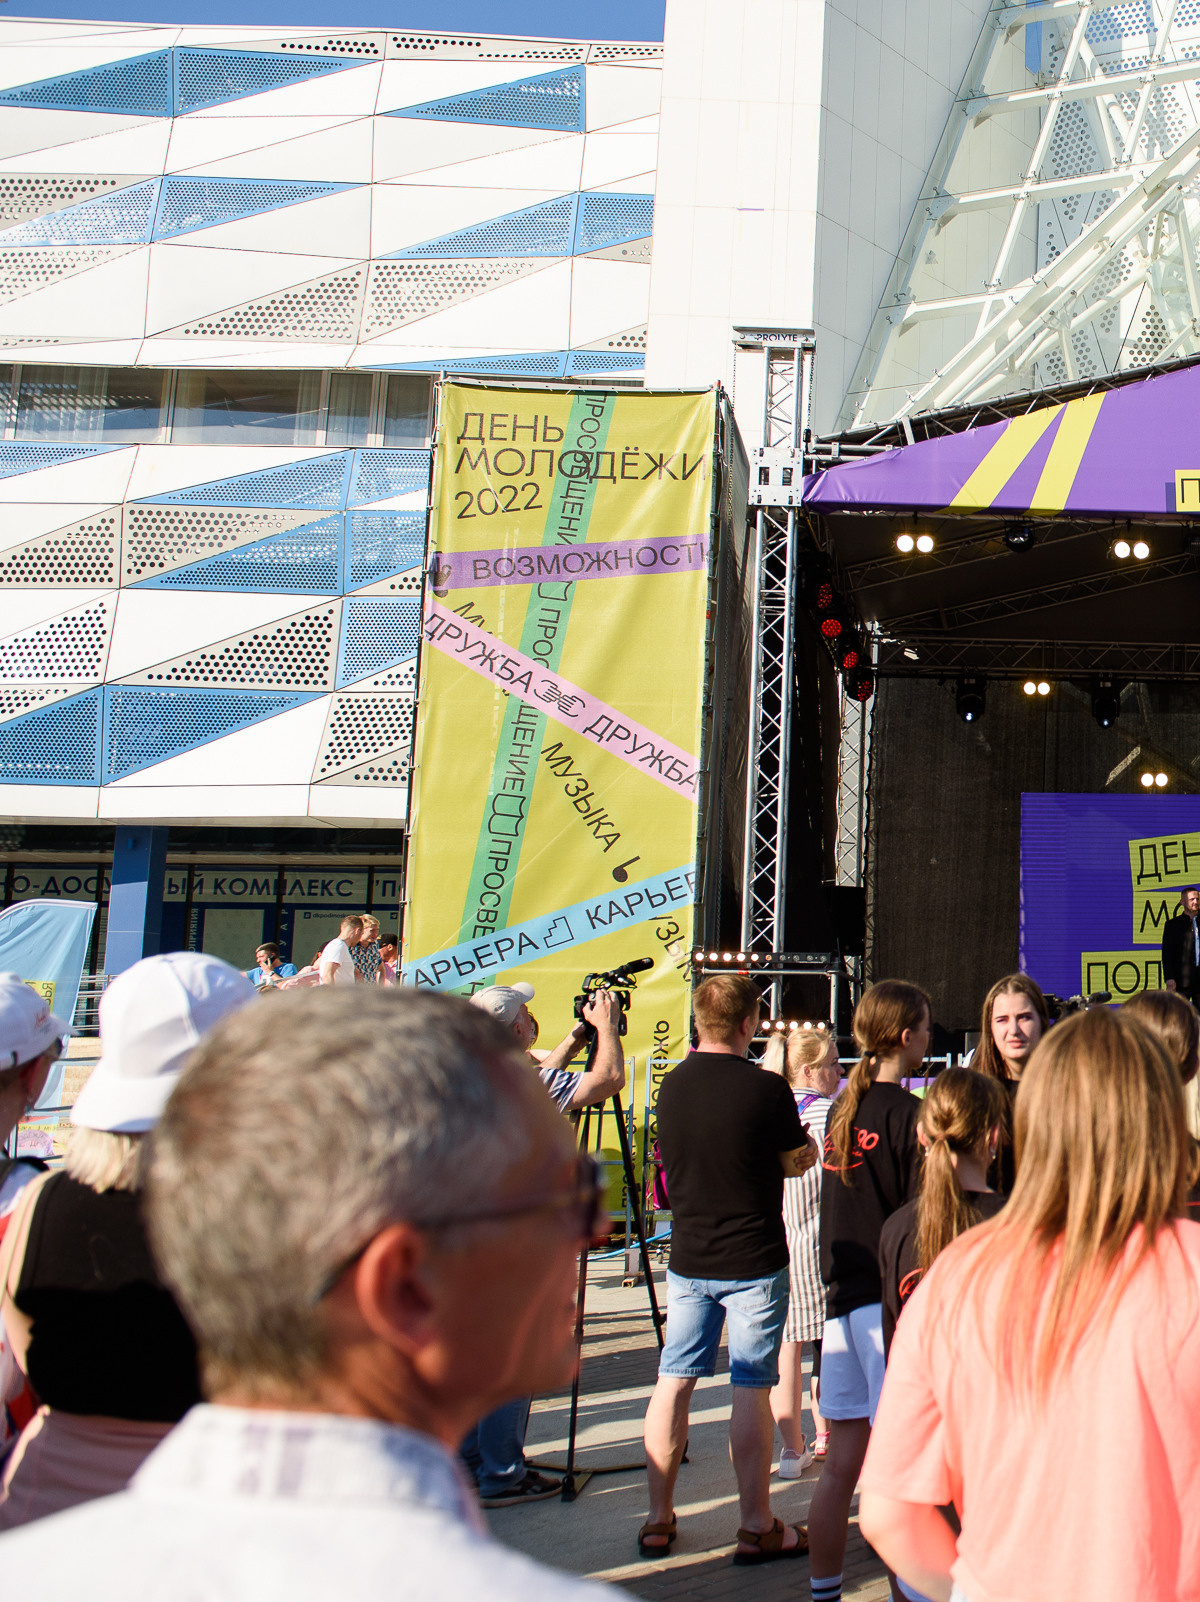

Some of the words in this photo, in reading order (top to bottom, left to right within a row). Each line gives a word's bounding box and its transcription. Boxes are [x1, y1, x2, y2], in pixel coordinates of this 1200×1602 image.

[457, 412, 565, 445] ДЕНЬ
[455, 446, 707, 484] МОЛОДЁЖИ
[455, 482, 543, 519] 2022
[424, 613, 536, 694] ДРУЖБА
[582, 714, 700, 794] ДРУЖБА
[541, 742, 621, 853] МУЗЫКА
[213, 877, 353, 898] КОМПЛЕКС
[403, 931, 540, 990] АРЬЕРА
[858, 1129, 879, 1150] 90
